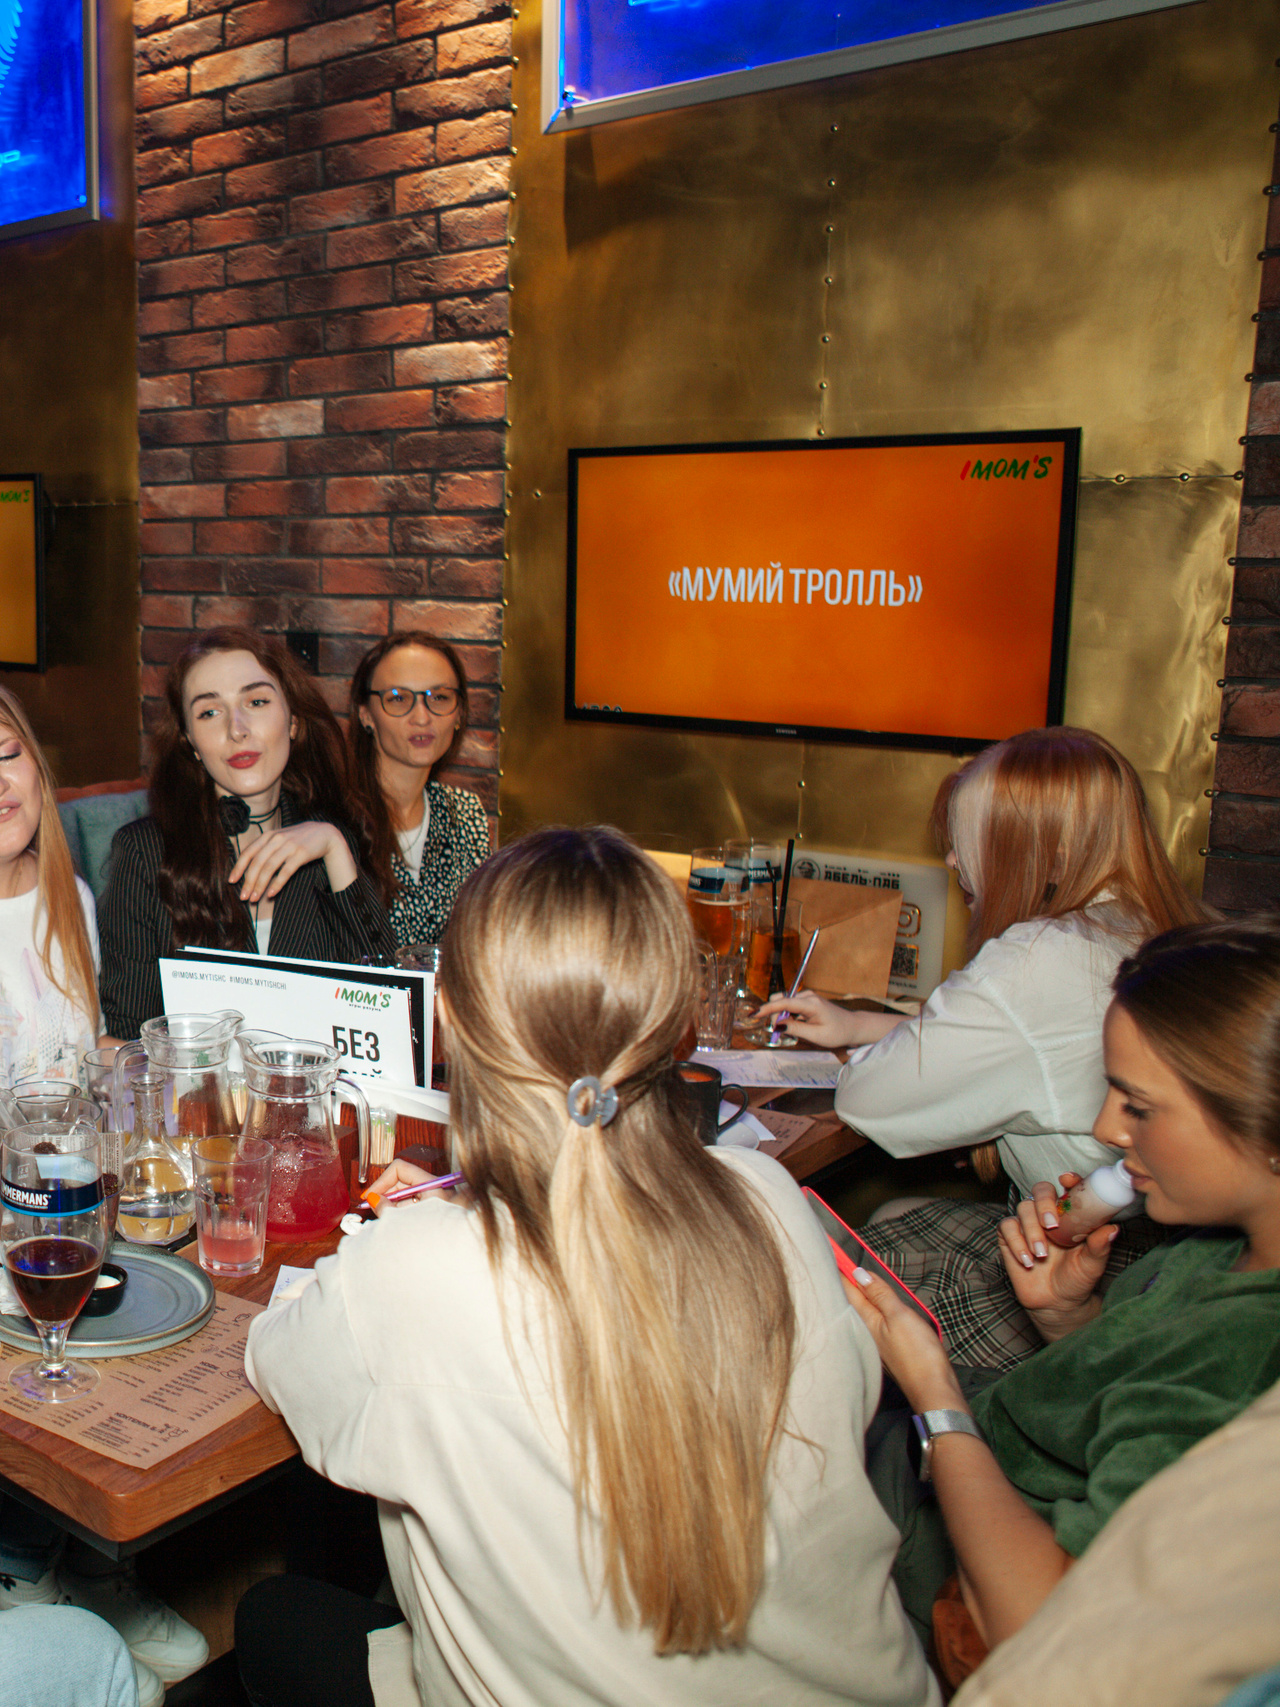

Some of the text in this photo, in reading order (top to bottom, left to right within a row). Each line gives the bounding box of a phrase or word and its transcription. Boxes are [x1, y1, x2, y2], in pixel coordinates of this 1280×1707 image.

[668, 561, 923, 607] «МУМИЙ ТРОЛЛЬ»
[332, 1025, 380, 1062] БЕЗ
